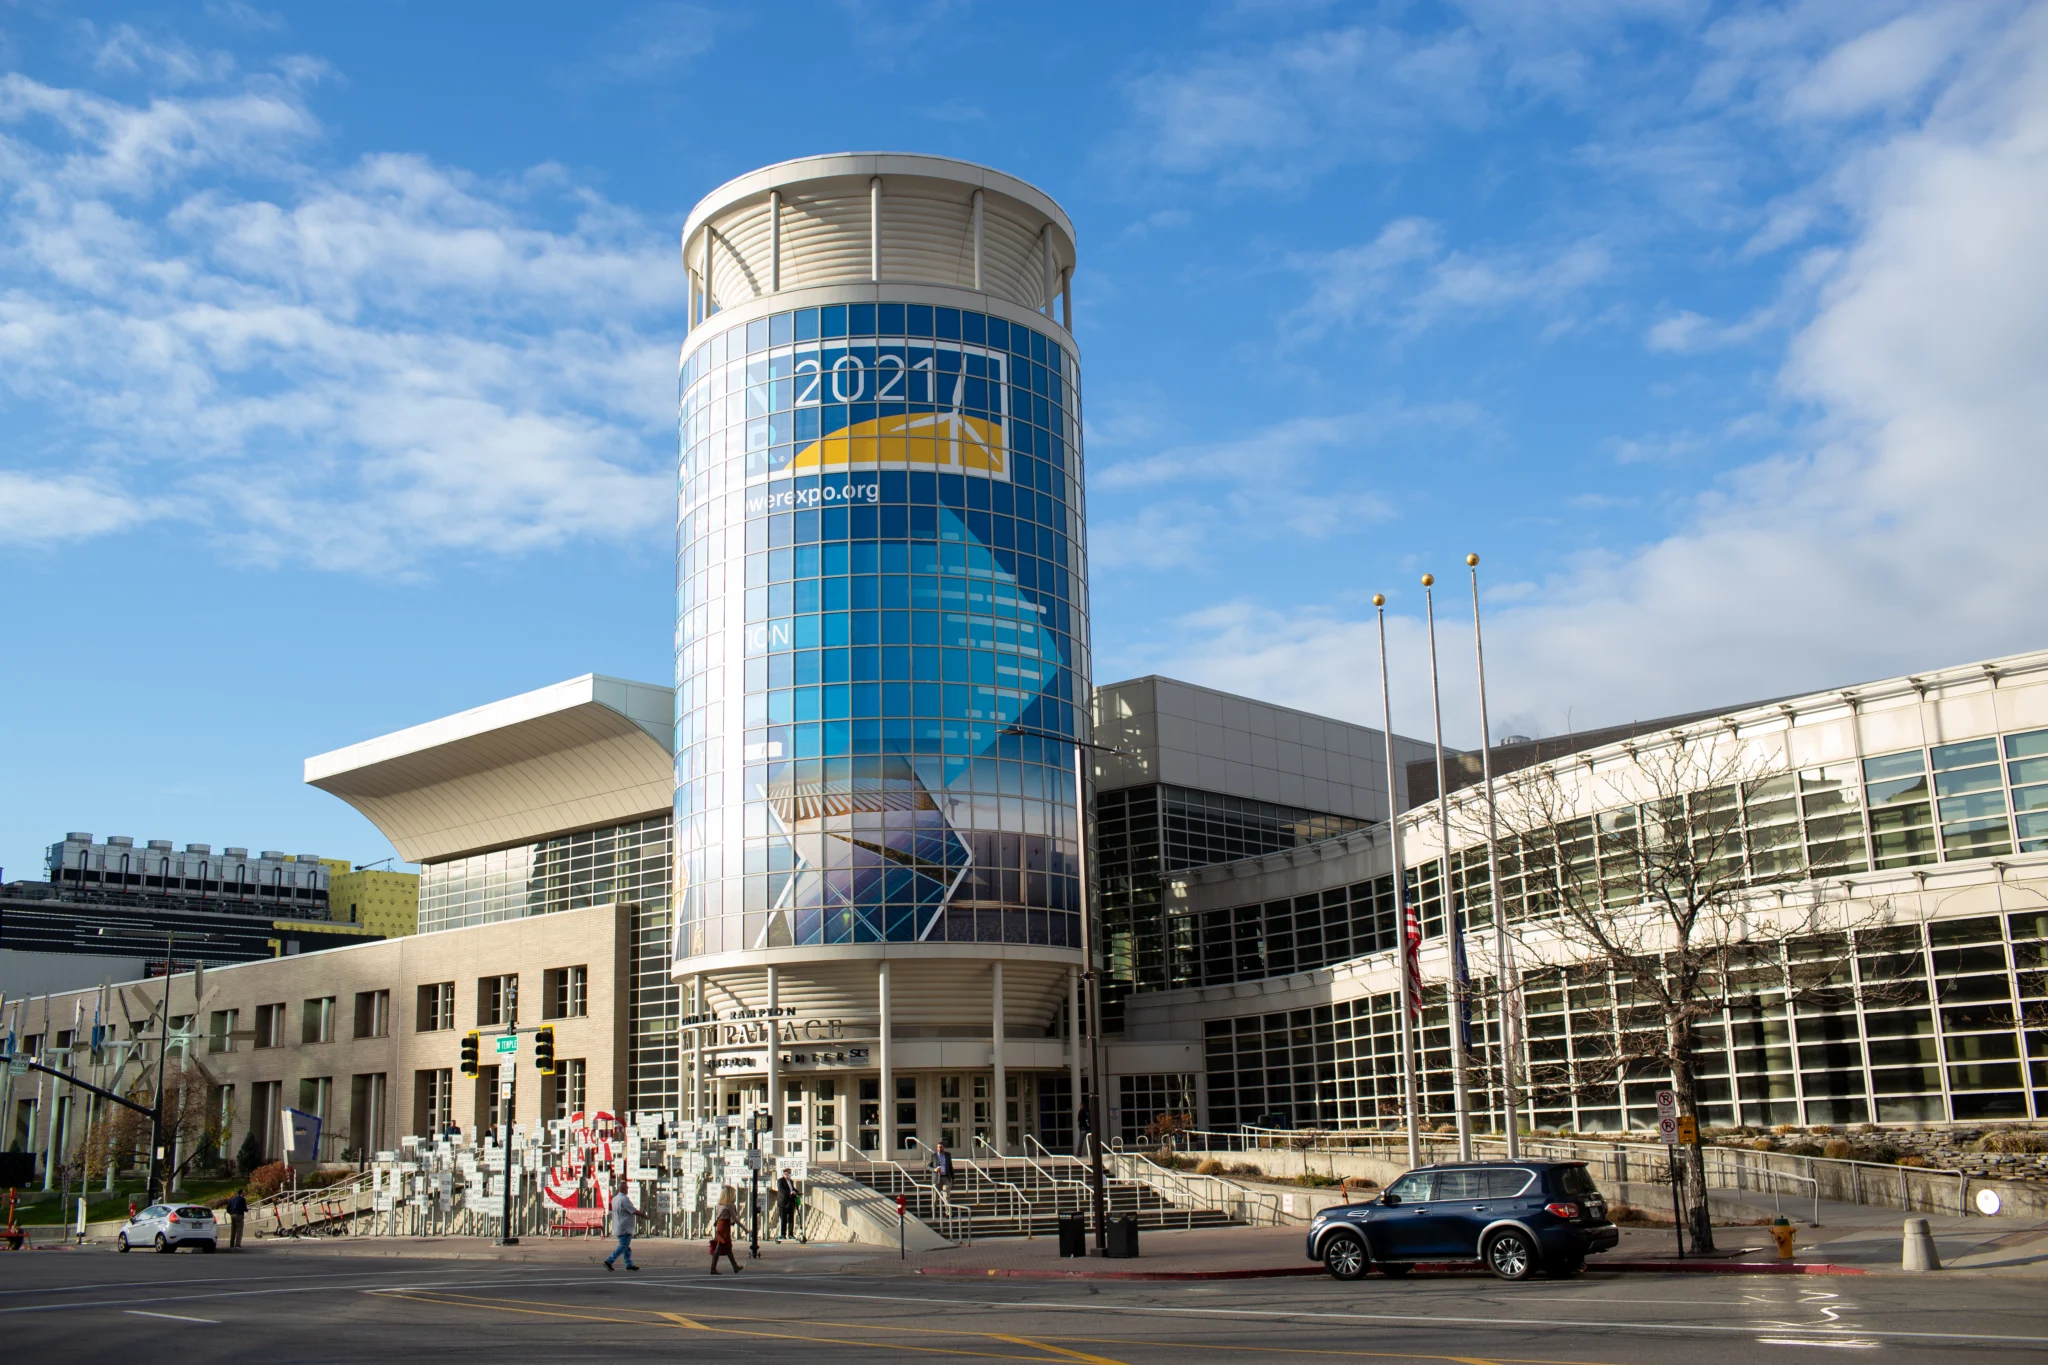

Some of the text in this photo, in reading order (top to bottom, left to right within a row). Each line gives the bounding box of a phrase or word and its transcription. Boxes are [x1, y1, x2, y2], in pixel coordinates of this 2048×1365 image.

[794, 354, 935, 408] 2021
[745, 622, 790, 651] ION
[729, 1007, 796, 1020] RAMPTON
[724, 1019, 844, 1047] PALACE
[501, 1039, 517, 1050] TEMPLE
[779, 1160, 803, 1168] BELIEVE
[736, 1167, 752, 1175] FOUND
[779, 1169, 802, 1177] DUBT
